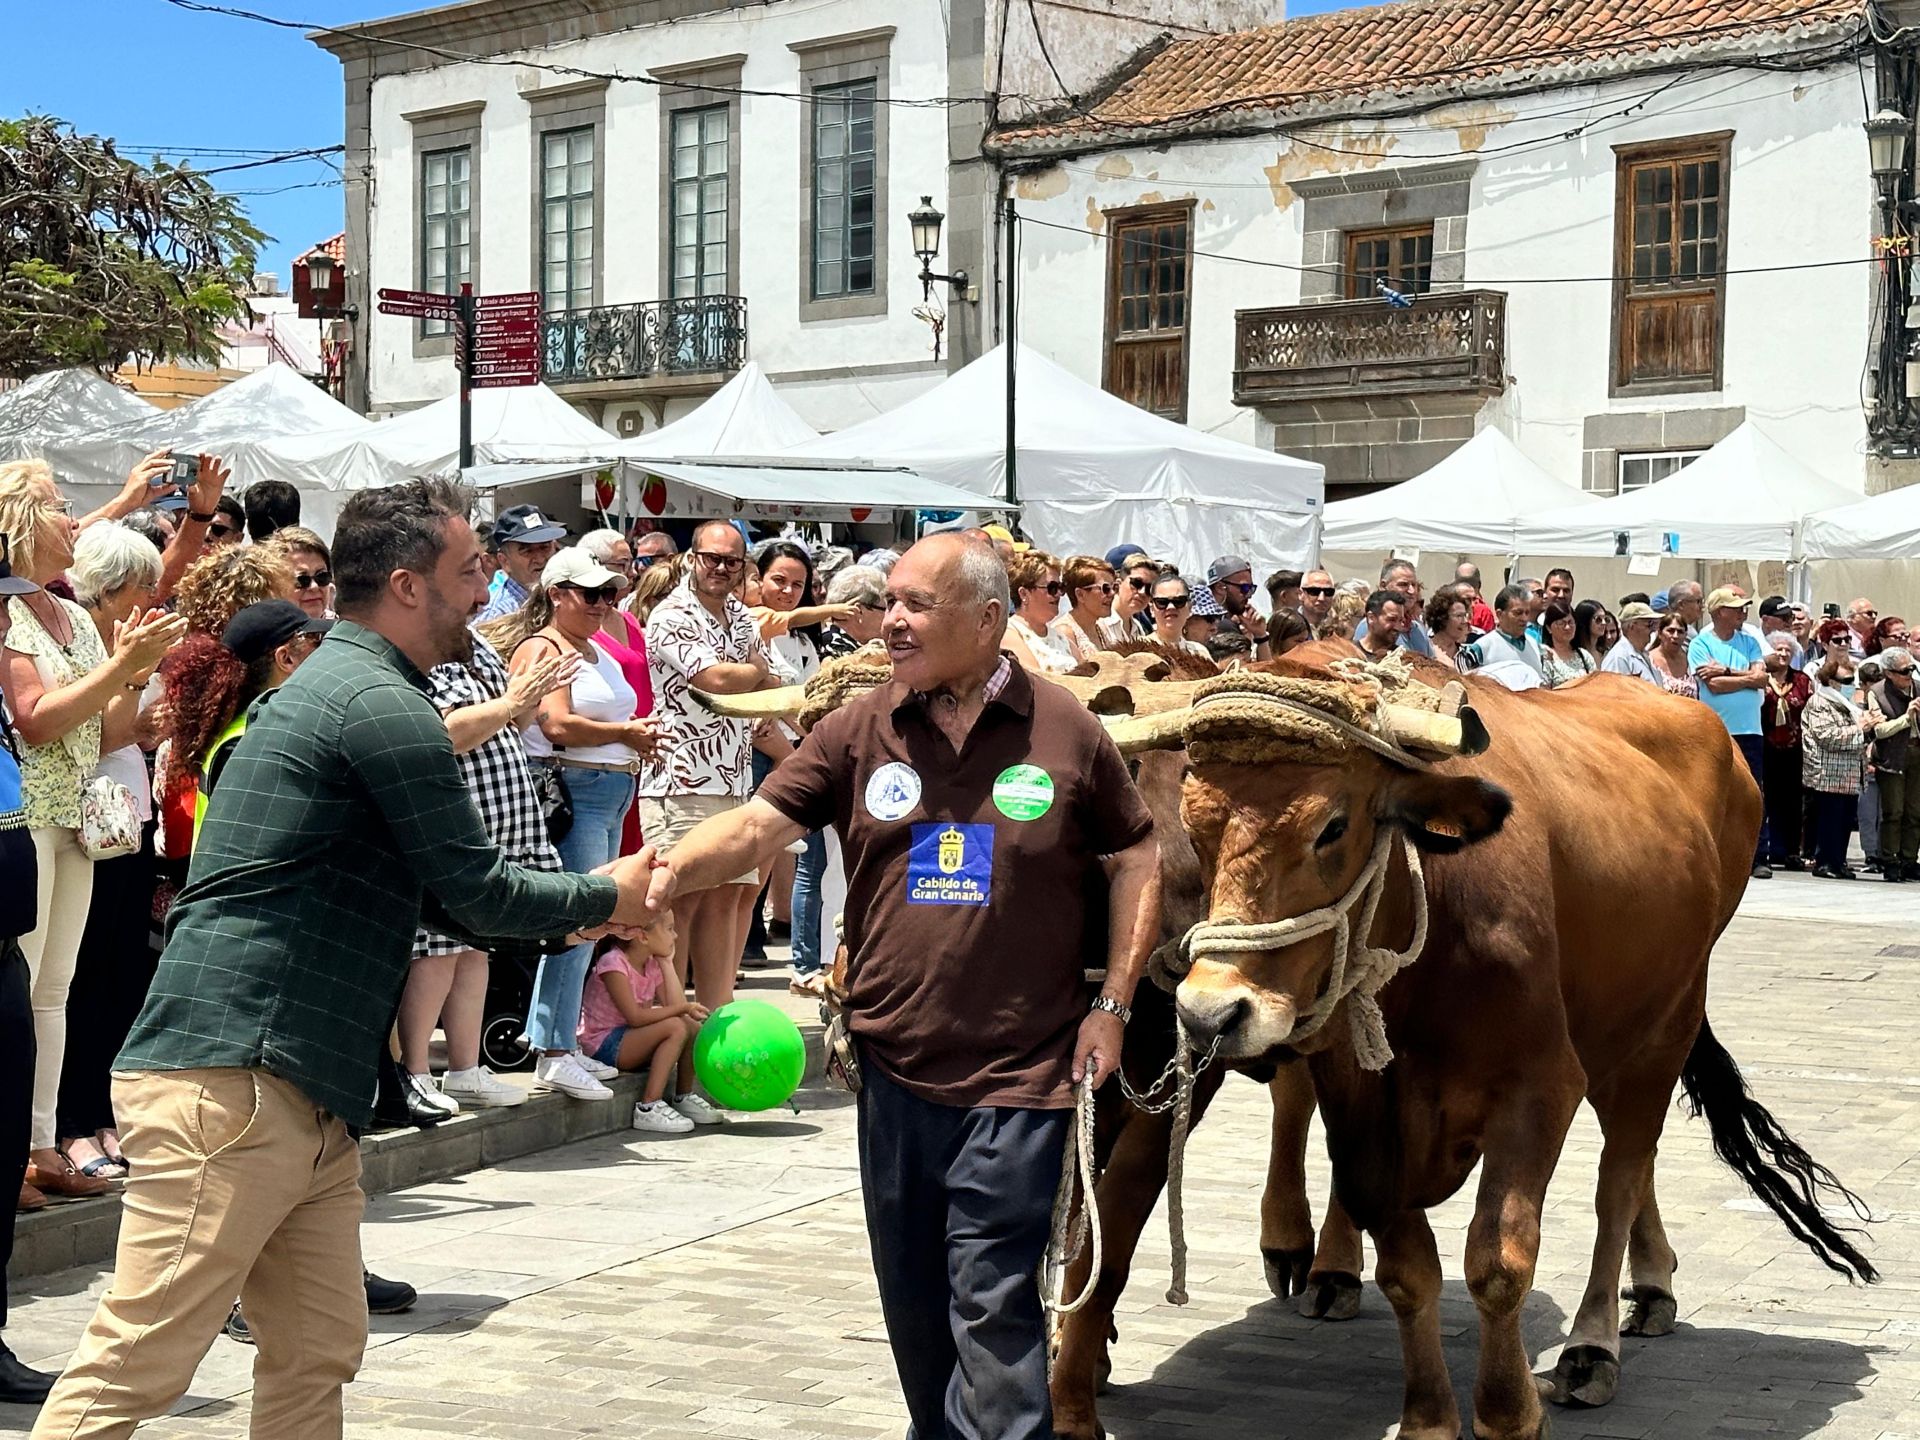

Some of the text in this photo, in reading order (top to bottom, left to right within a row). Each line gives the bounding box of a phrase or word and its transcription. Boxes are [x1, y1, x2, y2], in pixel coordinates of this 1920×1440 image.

[407, 294, 426, 303] Parking
[917, 877, 978, 890] Cabildo de
[911, 888, 985, 902] Gran Canaria
